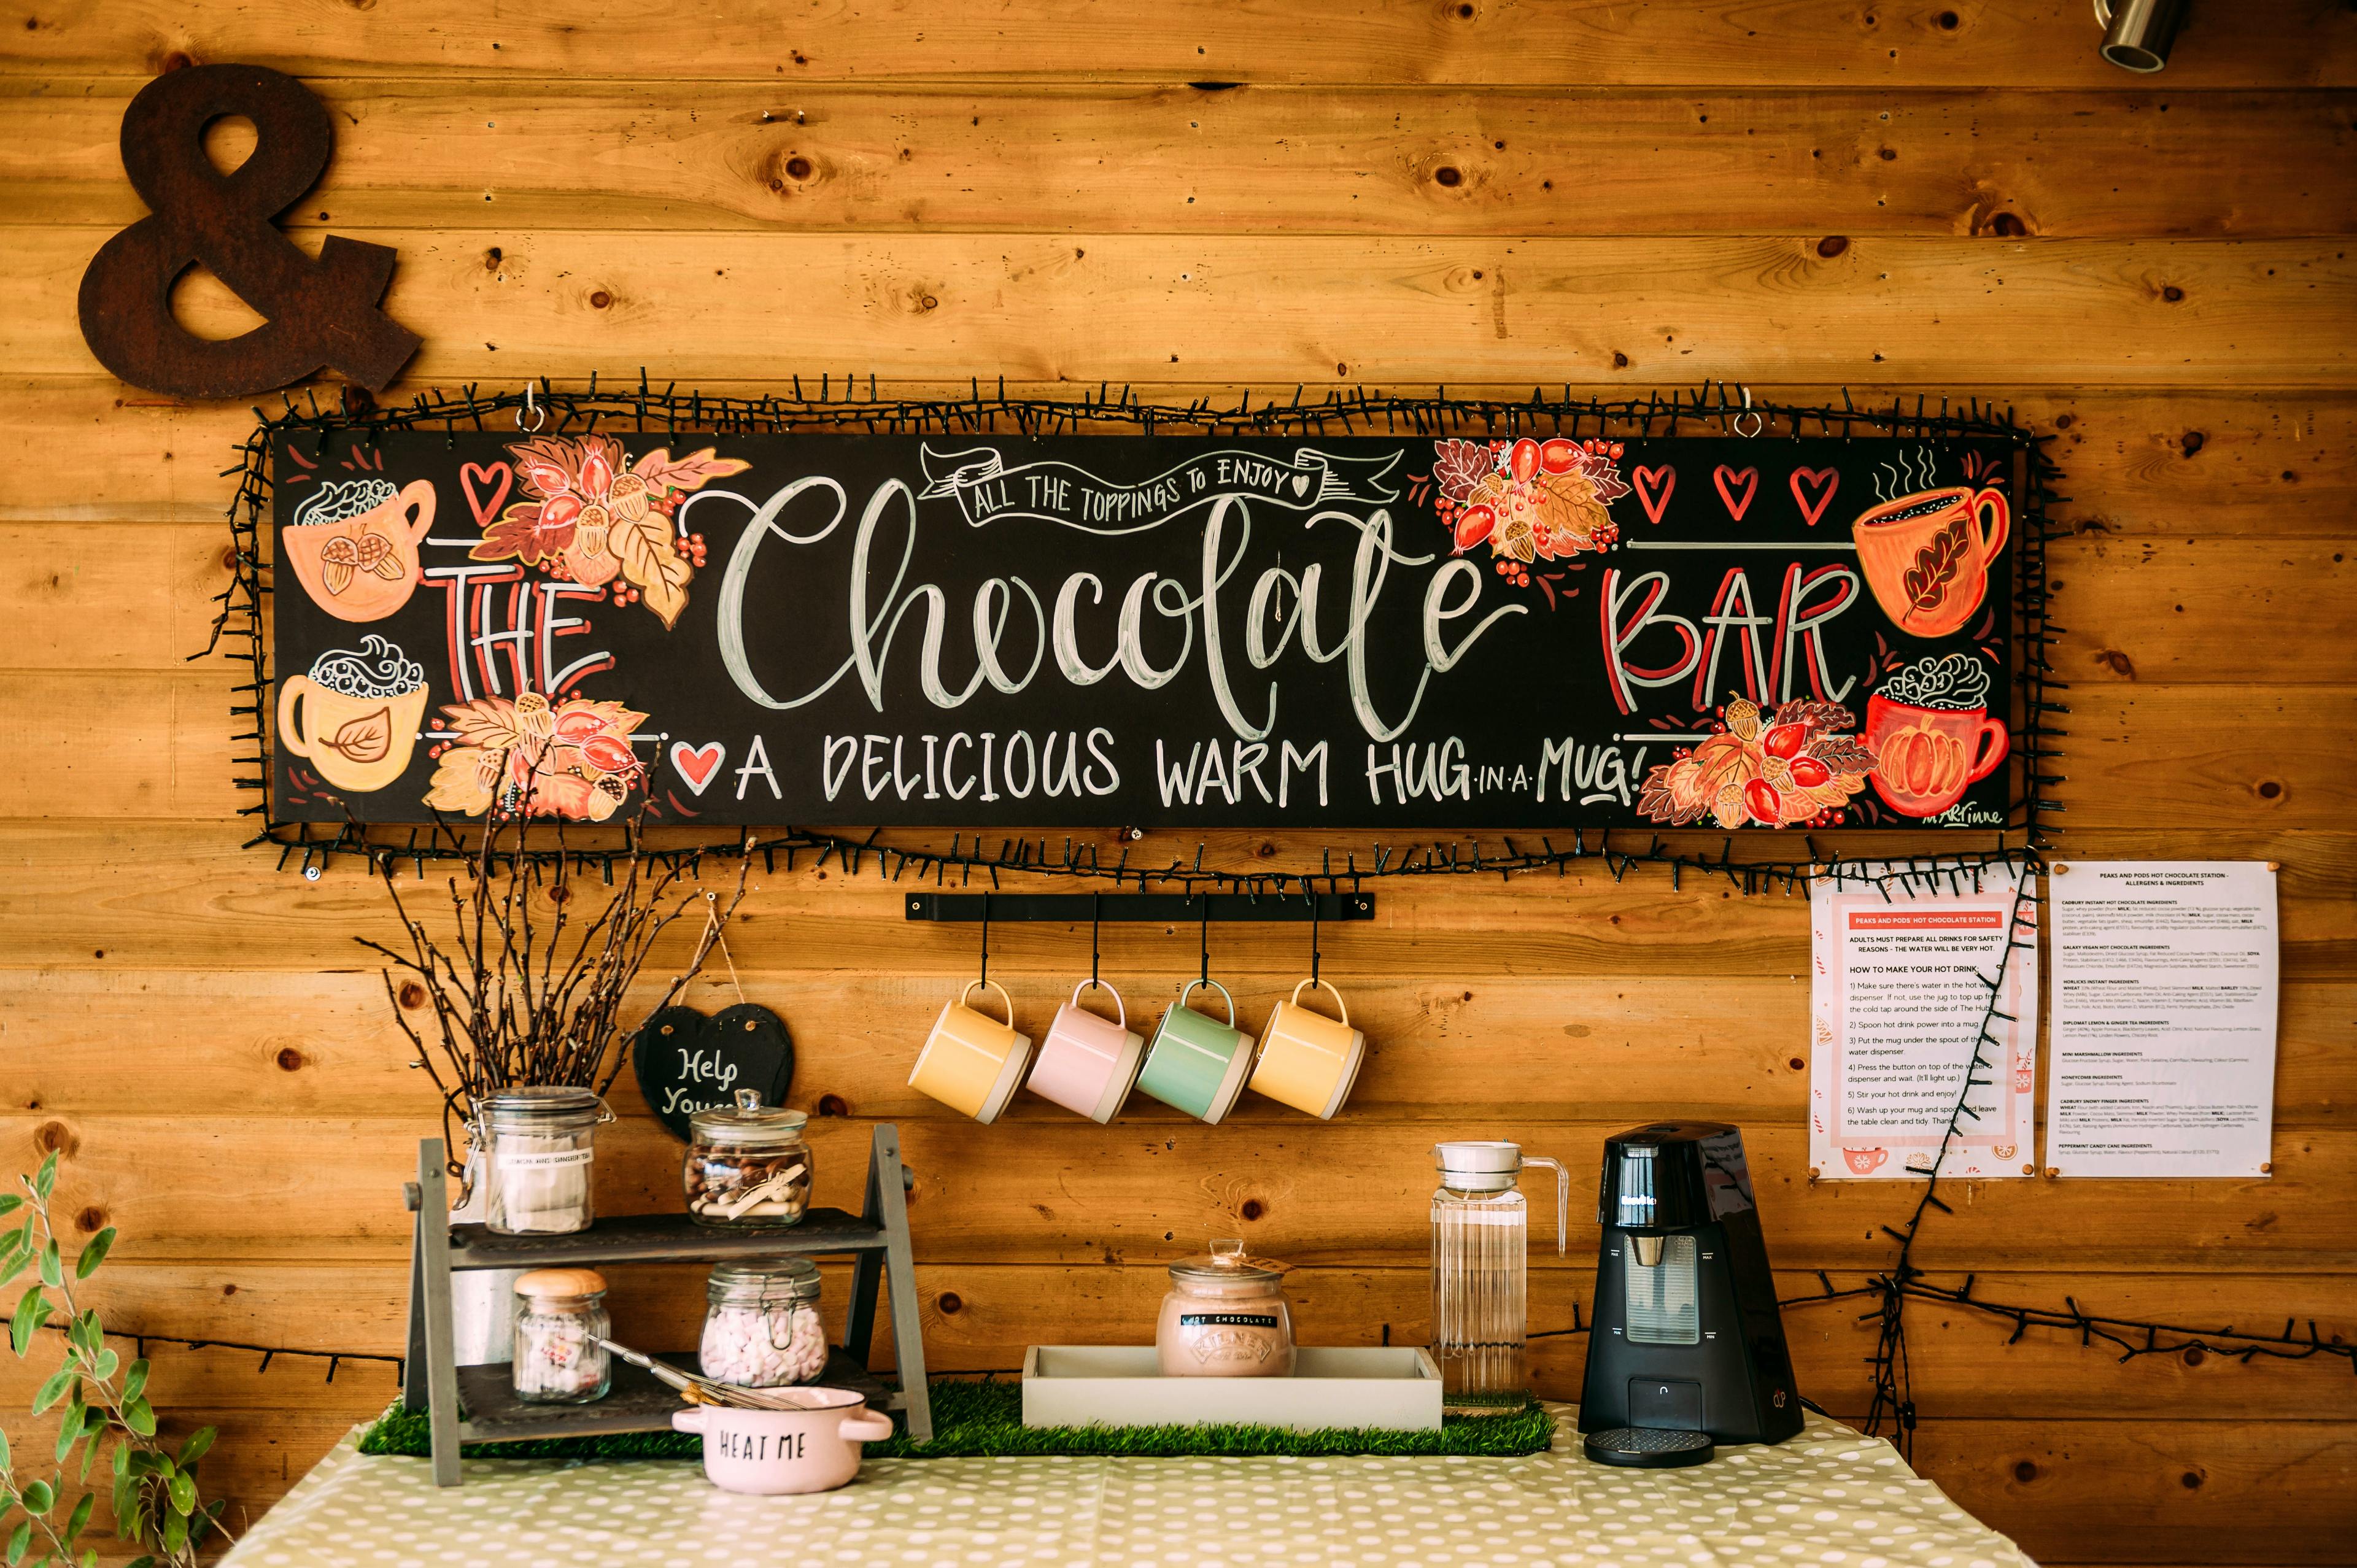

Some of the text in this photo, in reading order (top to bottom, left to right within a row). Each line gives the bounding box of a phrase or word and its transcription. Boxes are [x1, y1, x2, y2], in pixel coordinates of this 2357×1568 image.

[78, 63, 425, 396] &
[974, 458, 1290, 522] ALL THE TOPPINGS TO ENJOY
[420, 476, 1860, 742] THE Chocolate BAR
[735, 735, 783, 800] A
[823, 727, 1120, 801] DELICIOUS
[1156, 738, 1328, 808] WARM
[1365, 736, 1470, 805] HUG
[1537, 736, 1640, 806] MUG!
[1858, 1021, 1881, 1030] Spoon
[677, 1048, 738, 1092] Help
[1930, 1074, 1945, 1083] light
[1947, 1074, 1960, 1083] up.)
[1848, 1091, 1855, 1099] 5)
[1936, 1090, 1957, 1099] enjoy!
[1215, 1316, 1272, 1324] CHOCOLATE
[721, 1430, 808, 1461] HEAT ME
